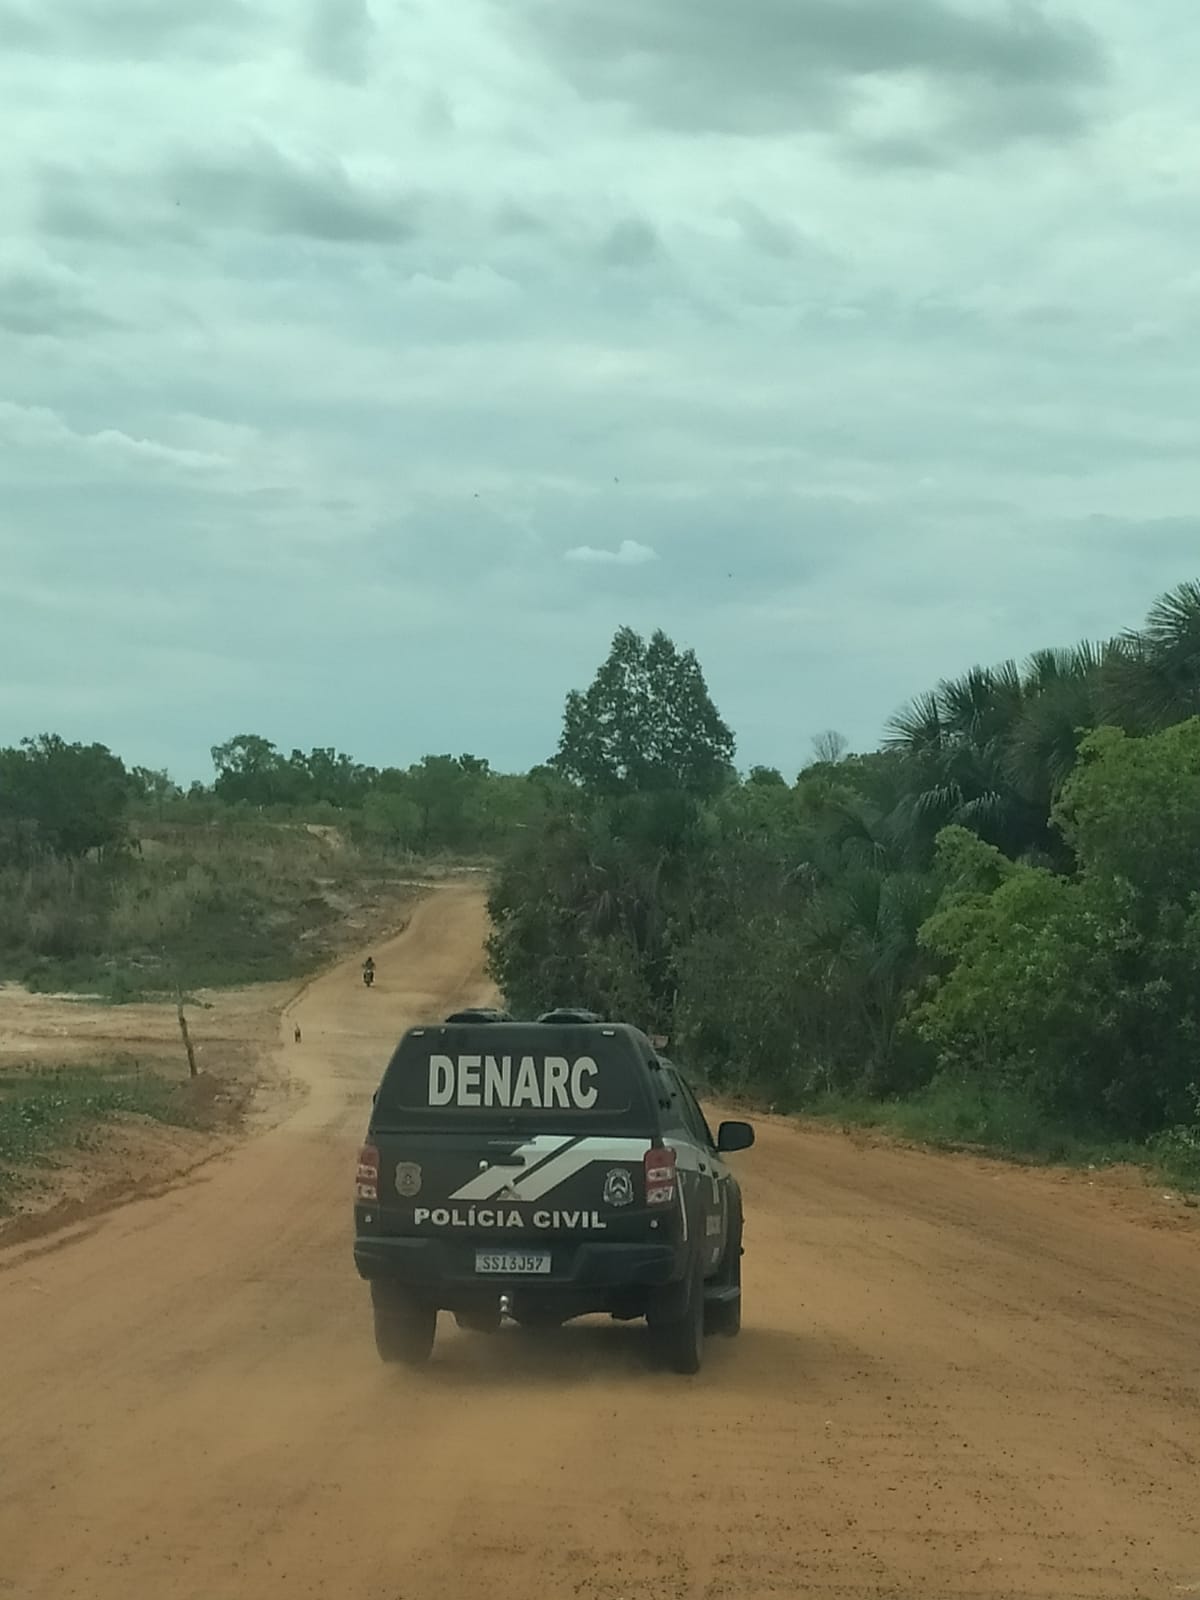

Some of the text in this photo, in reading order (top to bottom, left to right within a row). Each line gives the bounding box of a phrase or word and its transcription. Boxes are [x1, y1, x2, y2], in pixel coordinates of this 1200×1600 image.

[427, 1054, 598, 1109] DENARC
[413, 1205, 607, 1229] POLÍCIA CIVIL
